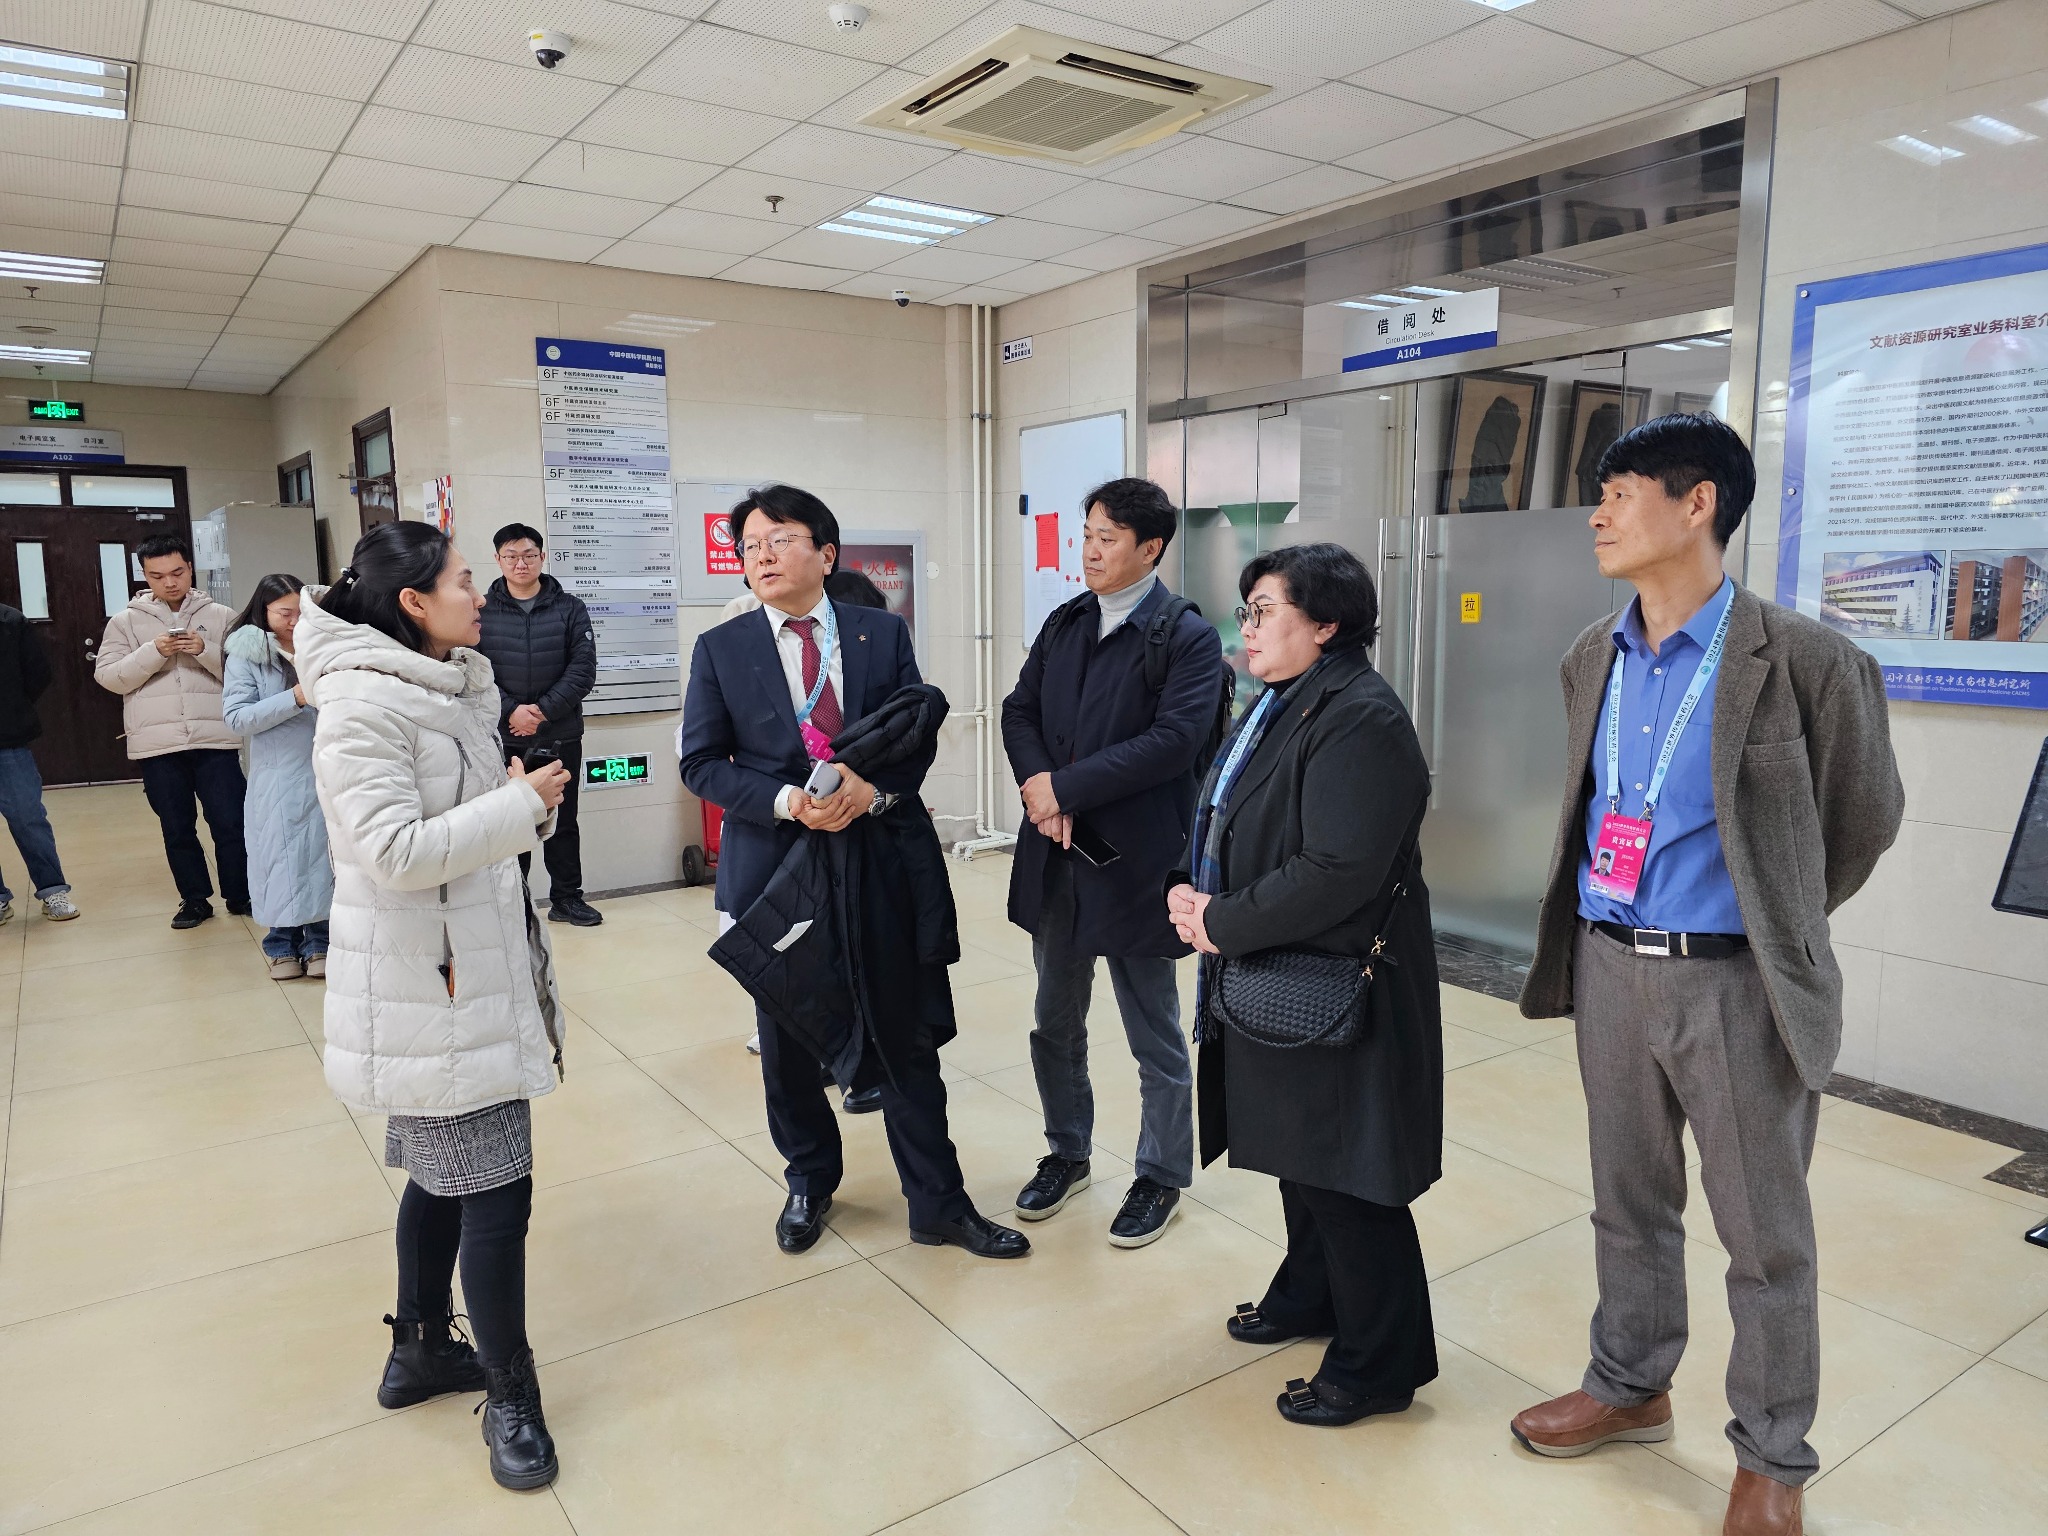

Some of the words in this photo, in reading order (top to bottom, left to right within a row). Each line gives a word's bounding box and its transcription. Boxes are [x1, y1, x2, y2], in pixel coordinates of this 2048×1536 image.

[1377, 306, 1446, 335] 借阅处
[1385, 333, 1417, 345] Circulation
[1418, 329, 1435, 339] Desk
[1396, 346, 1421, 360] A104
[543, 368, 560, 379] 6F
[545, 397, 560, 407] 6F
[66, 408, 79, 416] EXIT
[545, 411, 561, 422] 6F
[83, 437, 105, 445] 自习室
[549, 468, 566, 479] 5F
[551, 510, 568, 520] 4F
[554, 551, 570, 562] 3F
[710, 562, 741, 571] 可燃物品
[1464, 597, 1476, 612] 拉
[1883, 672, 2032, 690] 国中医科学院中医药信息研究所
